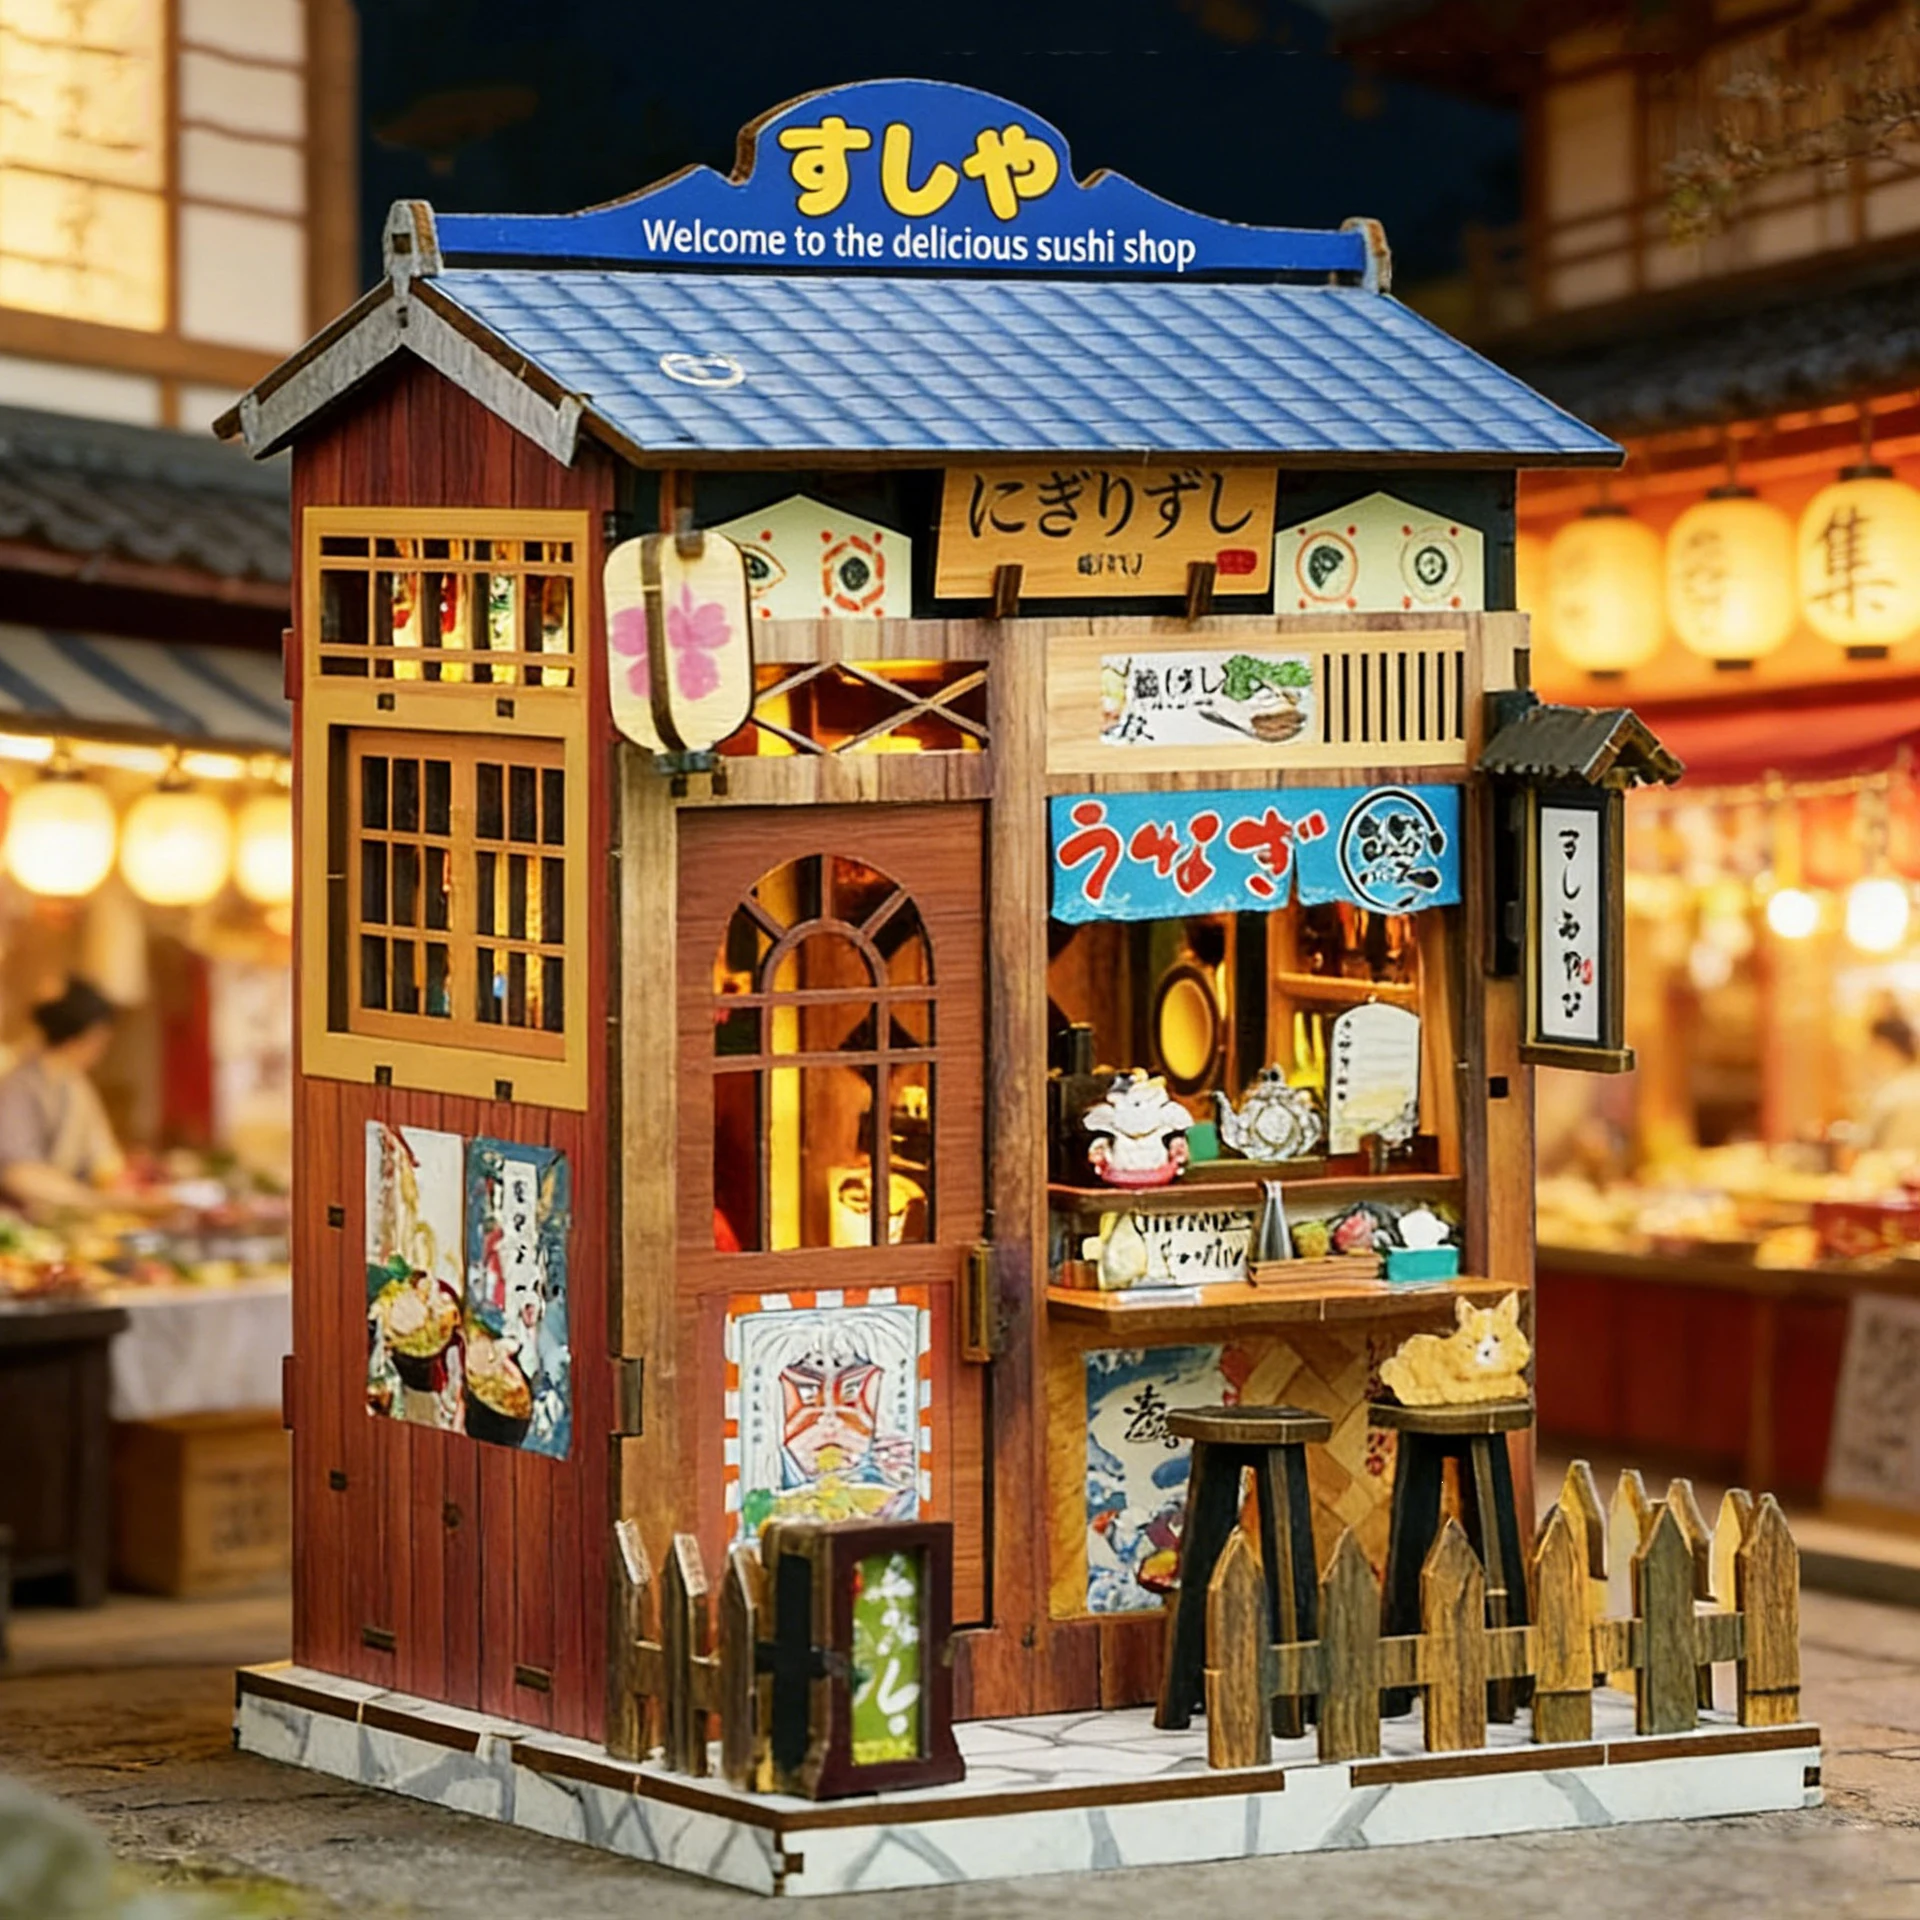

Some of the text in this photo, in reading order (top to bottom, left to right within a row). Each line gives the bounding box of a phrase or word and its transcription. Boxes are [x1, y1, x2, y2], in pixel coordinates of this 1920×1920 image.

[778, 116, 1060, 220] すしや
[641, 218, 1197, 273] Welcome to the delicious sushi shop
[968, 469, 1254, 539] にぎりずし
